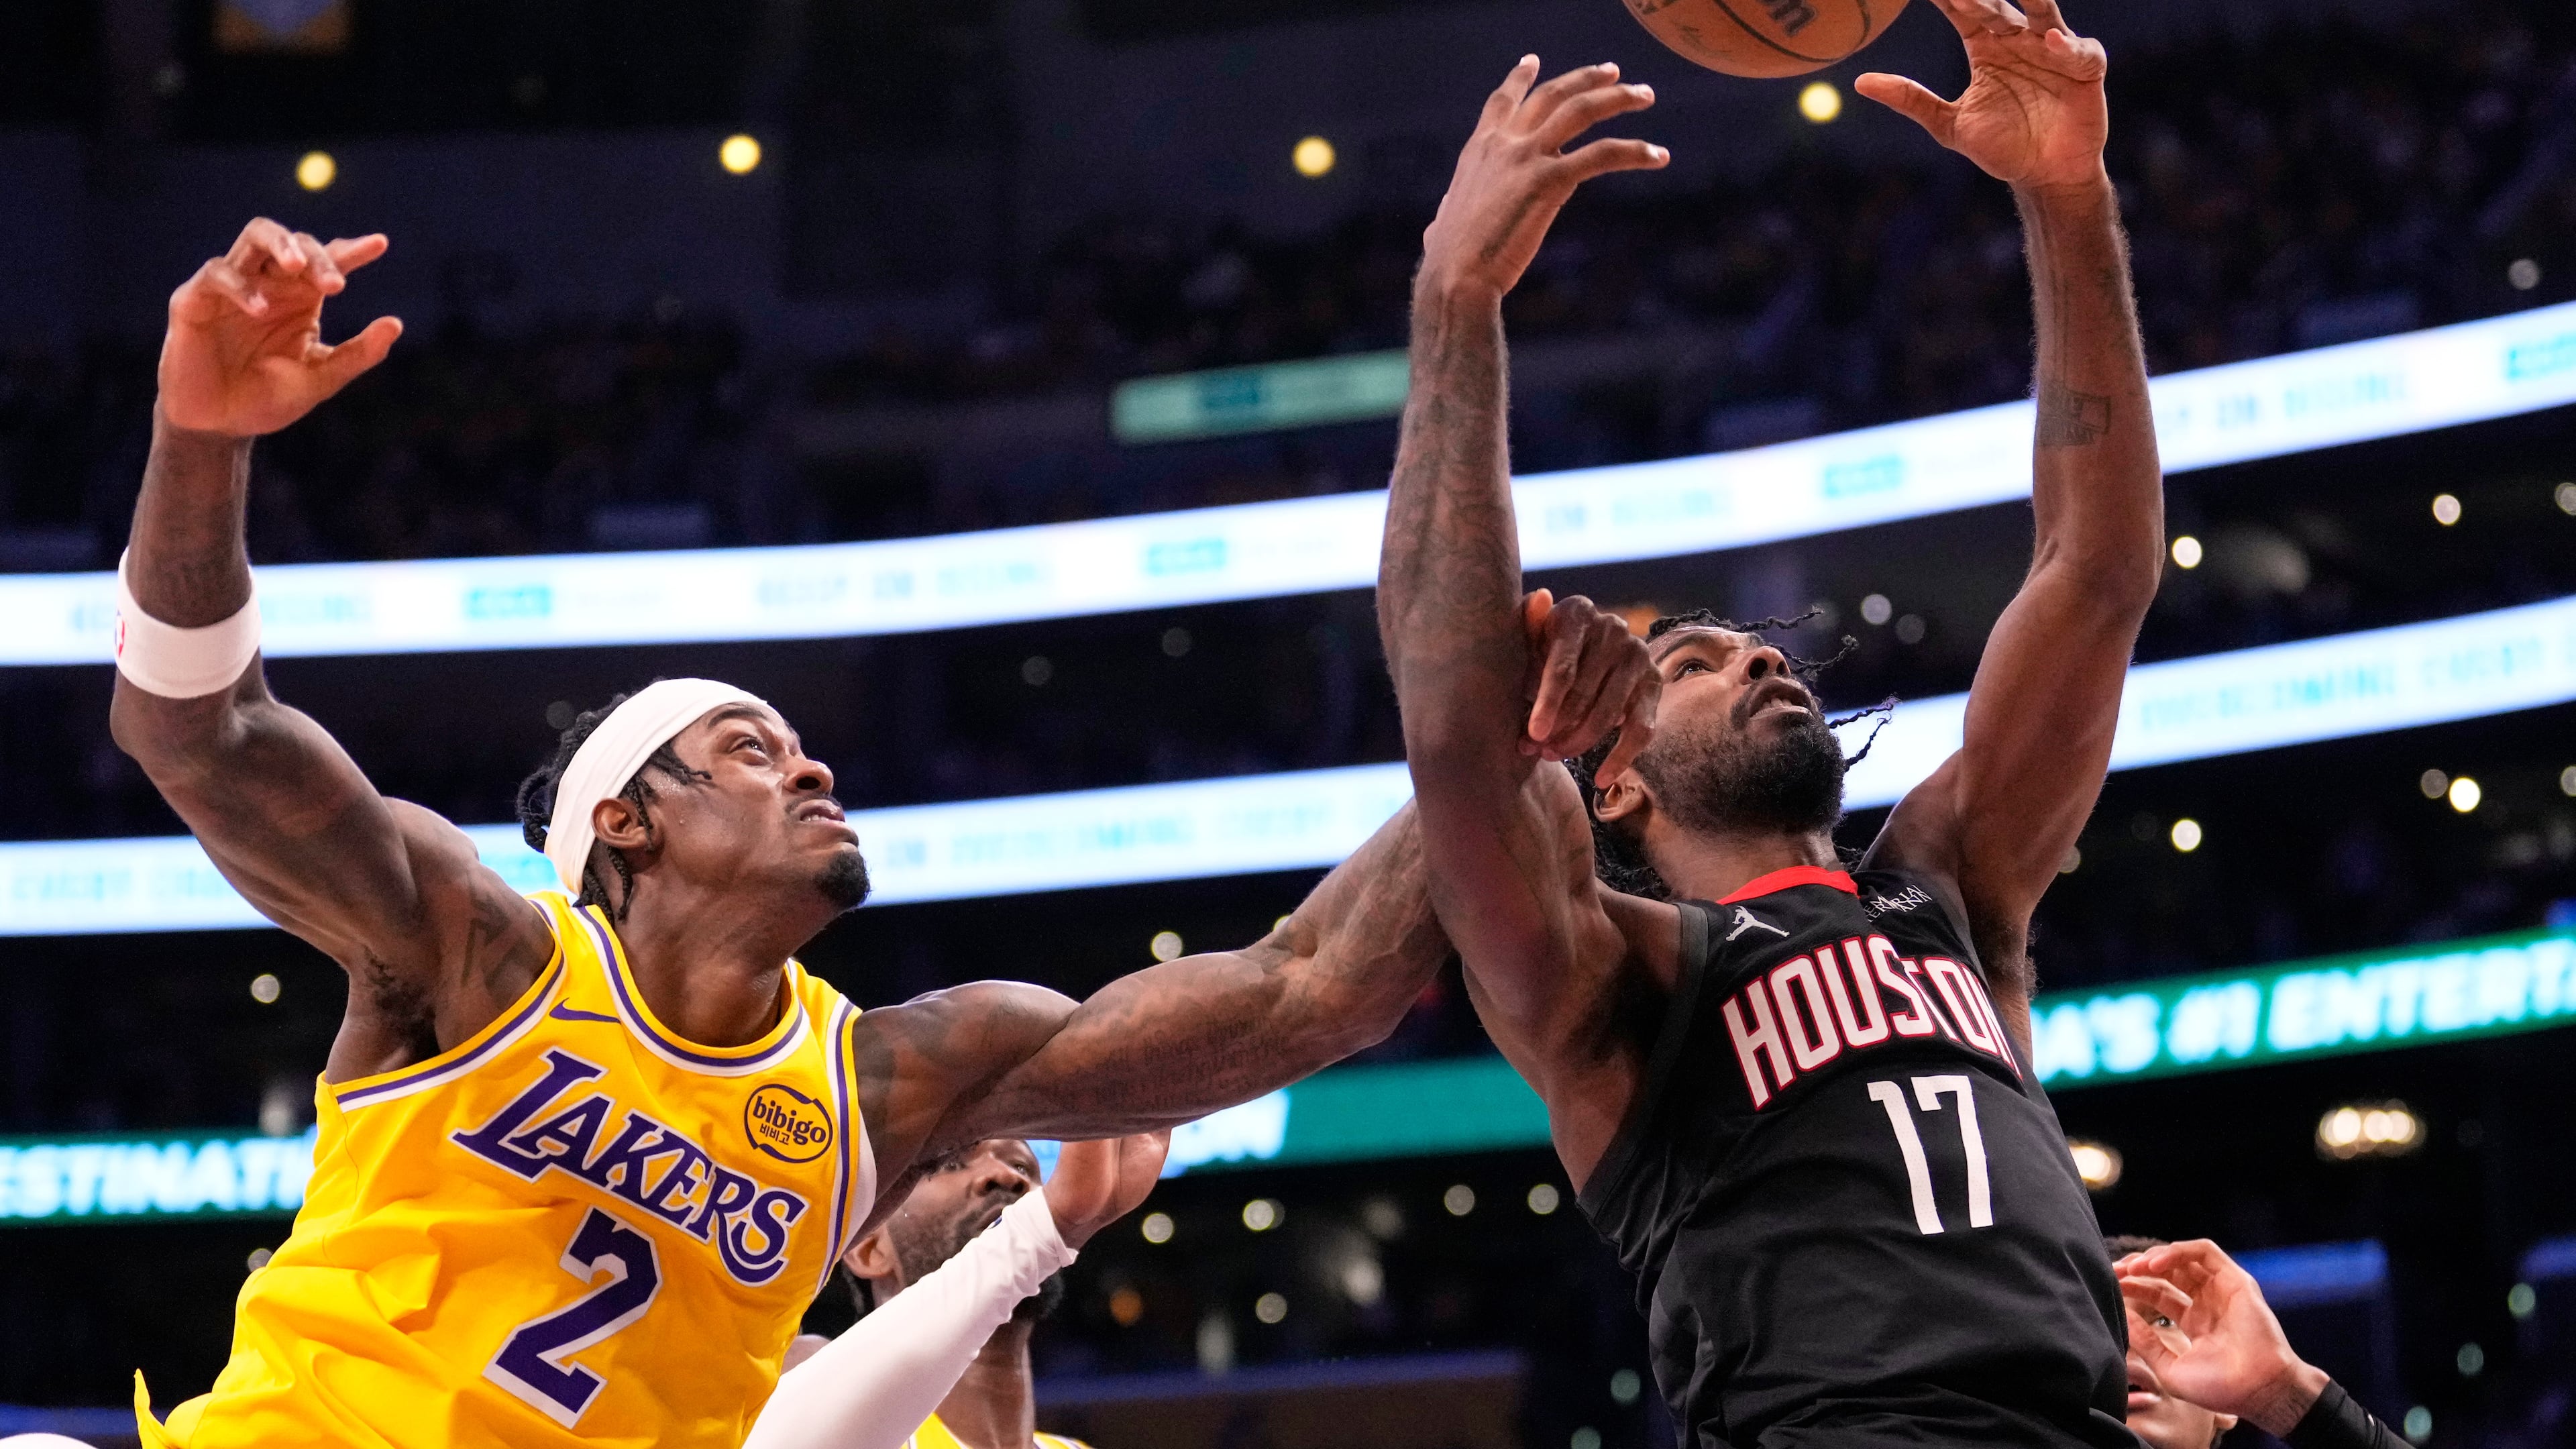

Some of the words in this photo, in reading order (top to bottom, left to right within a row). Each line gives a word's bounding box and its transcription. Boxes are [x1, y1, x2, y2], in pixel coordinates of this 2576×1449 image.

[1721, 935, 2024, 1112] HOUSTON
[2031, 994, 2160, 1081] A'S
[448, 1046, 810, 1287] LAKERS
[753, 1095, 826, 1145] bibigo
[759, 1124, 790, 1145] 비비고
[1868, 1075, 1994, 1235] 17
[482, 1206, 663, 1430] 2
